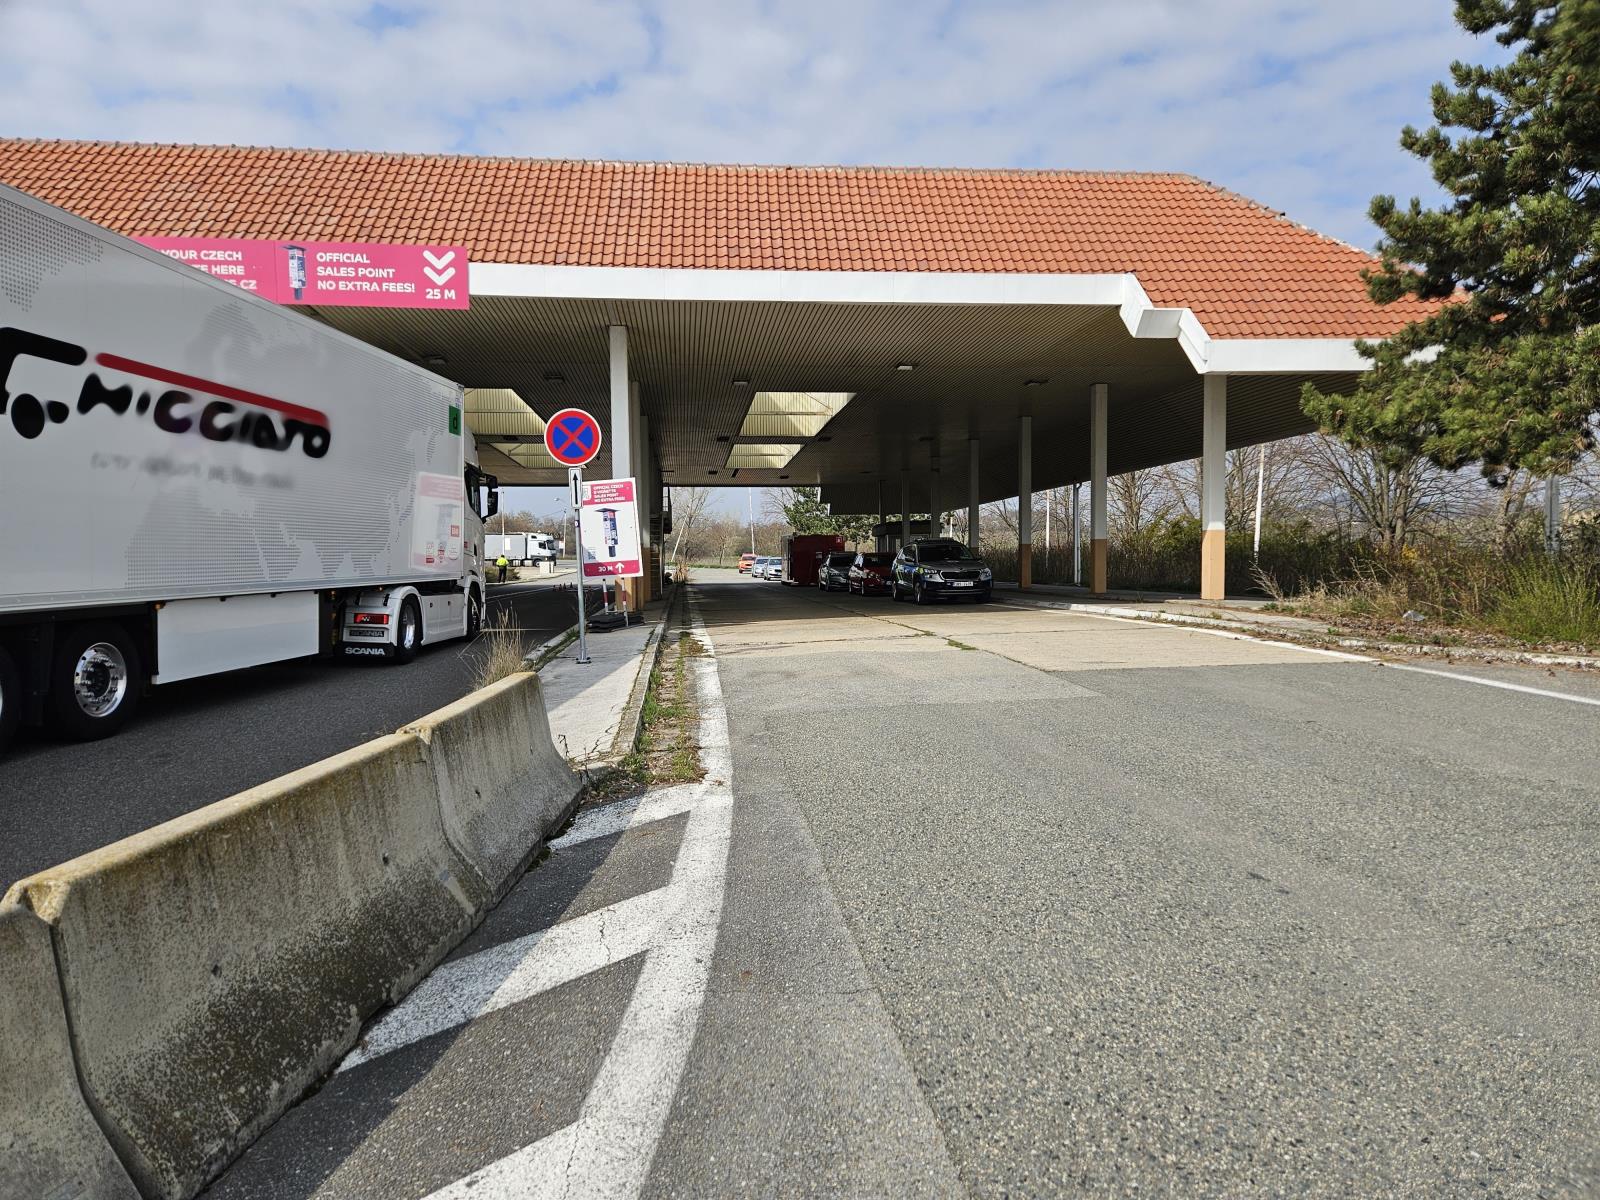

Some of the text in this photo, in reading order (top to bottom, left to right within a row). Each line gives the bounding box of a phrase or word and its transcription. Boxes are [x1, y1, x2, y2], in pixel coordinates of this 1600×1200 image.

[200, 250, 242, 261] CZECH
[316, 252, 370, 264] OFFICIAL
[211, 264, 245, 275] HERE
[316, 266, 396, 278] SALES POINT
[317, 280, 415, 293] NO EXTRA FEES!
[425, 288, 456, 300] 25 M
[345, 647, 385, 656] SCANIA
